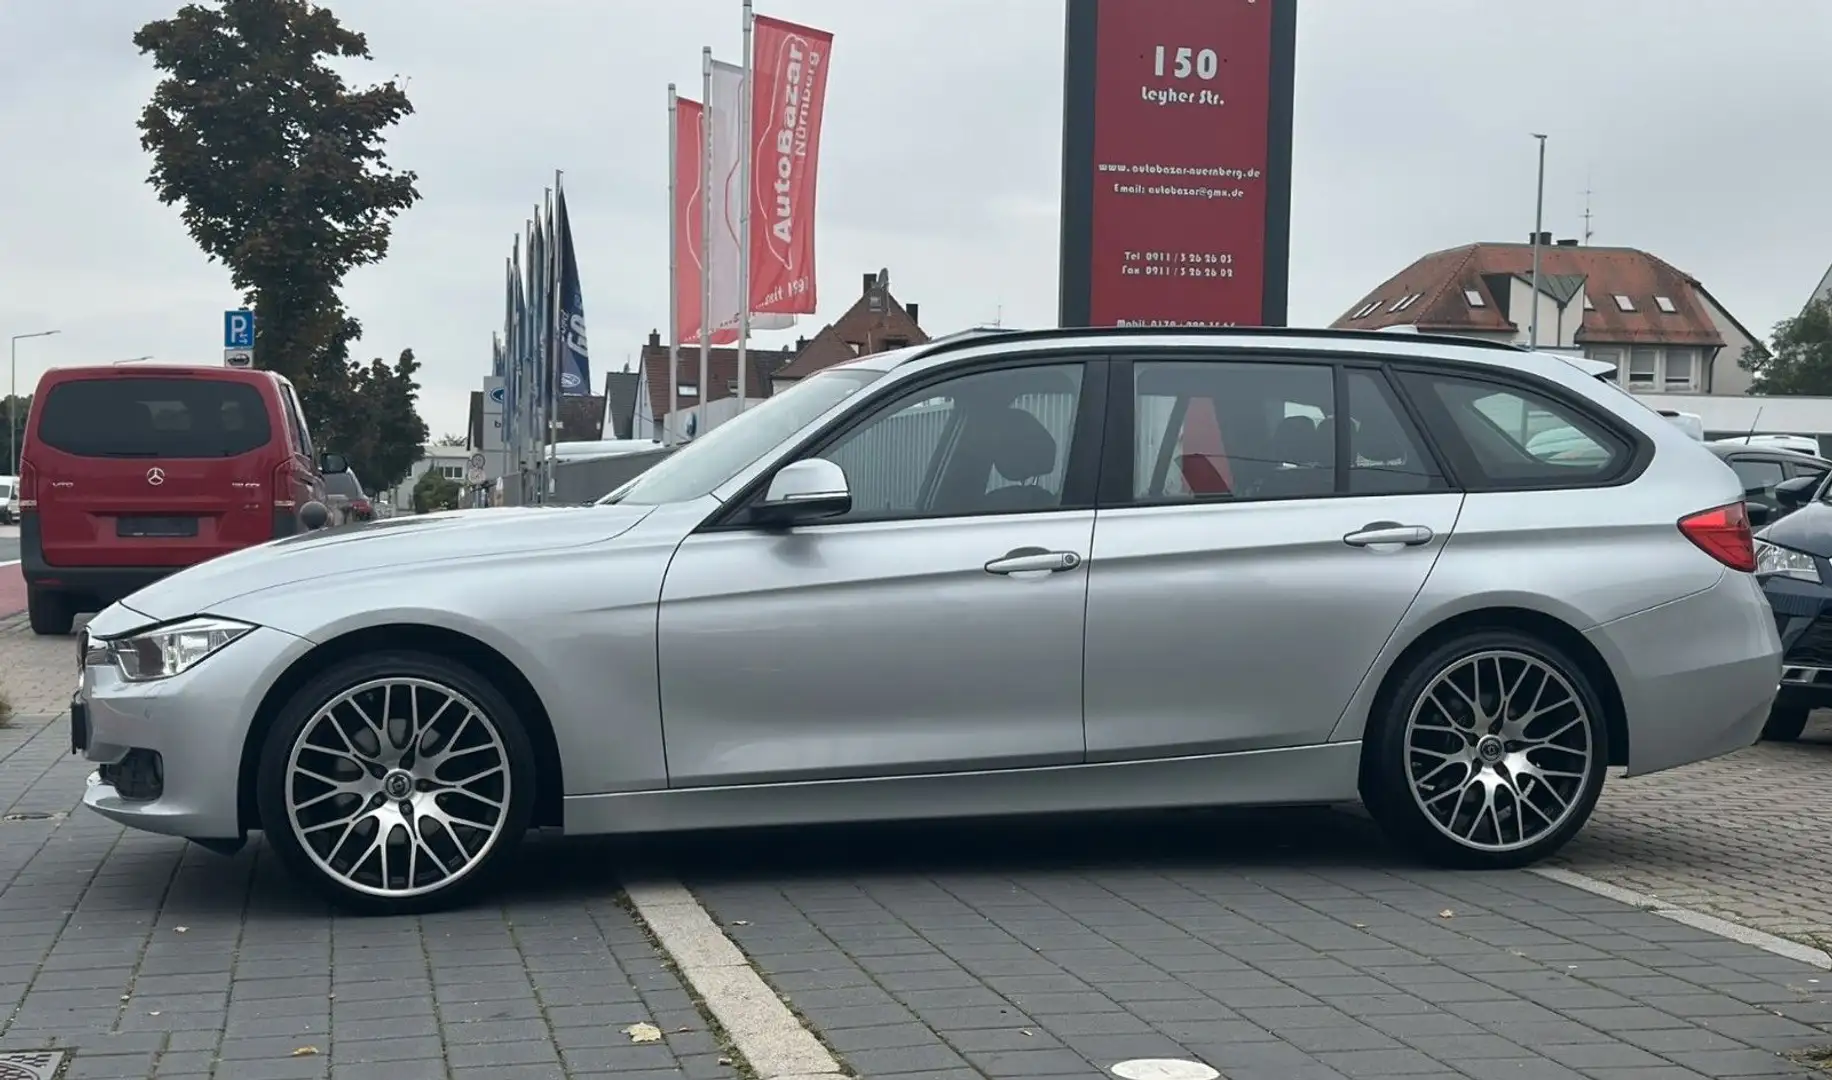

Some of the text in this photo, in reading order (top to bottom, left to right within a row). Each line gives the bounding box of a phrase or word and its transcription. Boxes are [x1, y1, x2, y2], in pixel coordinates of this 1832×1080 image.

[1154, 45, 1218, 80] 150
[1141, 86, 1225, 106] Leyher Str.
[773, 43, 803, 243] AutoBazar
[1114, 183, 1244, 199] Email: autobazar@gmx.de
[1124, 251, 1140, 261] Tel
[231, 315, 247, 343] P
